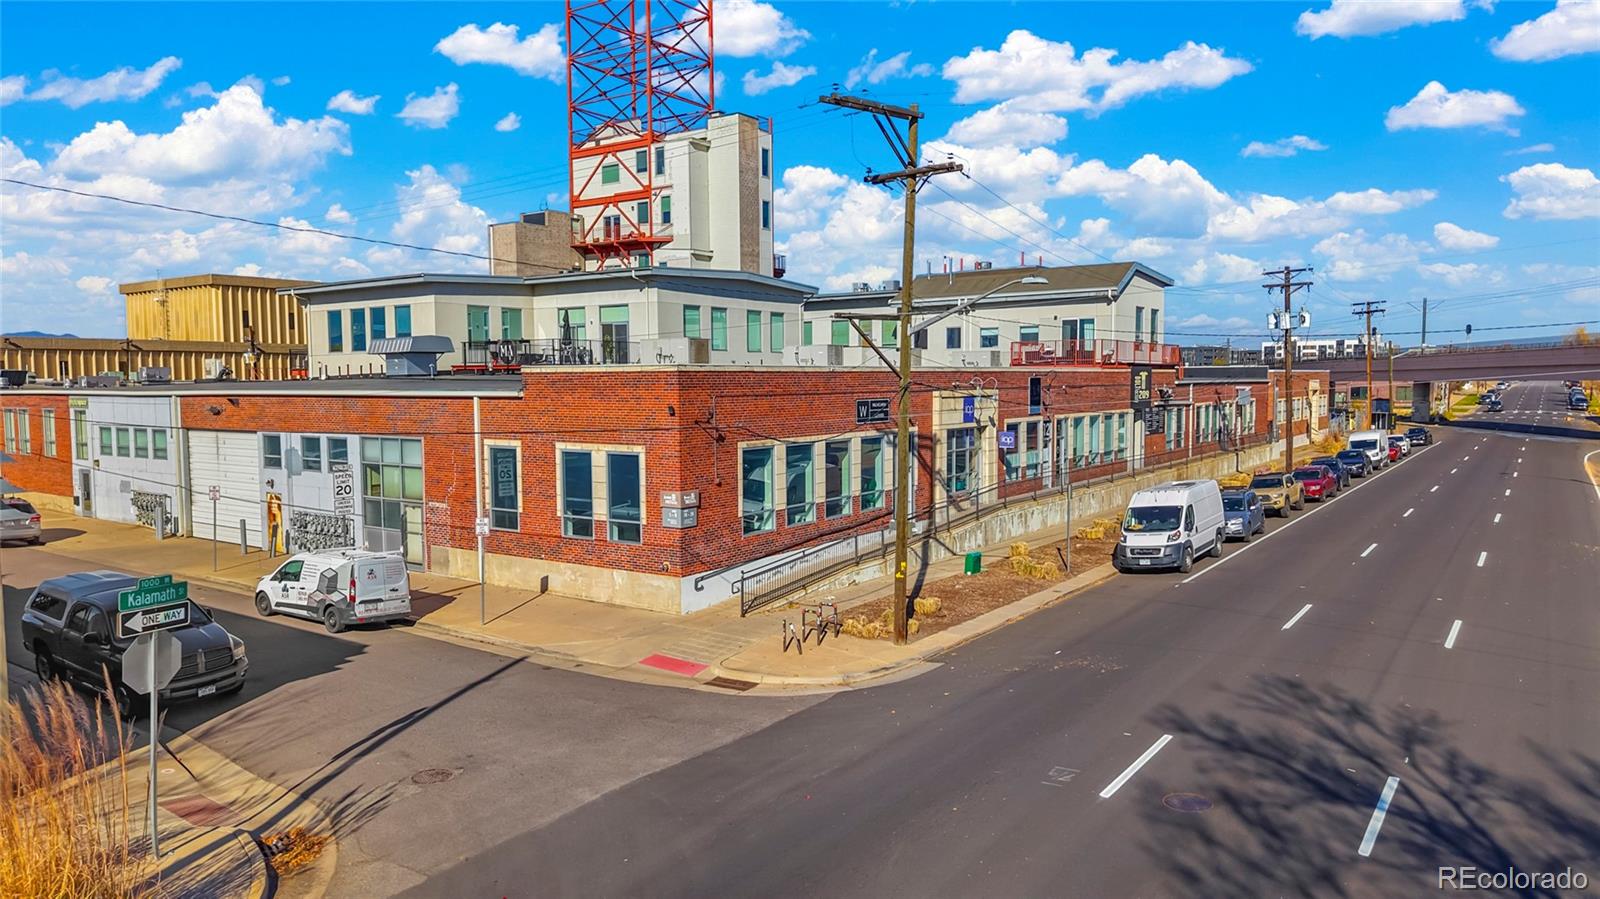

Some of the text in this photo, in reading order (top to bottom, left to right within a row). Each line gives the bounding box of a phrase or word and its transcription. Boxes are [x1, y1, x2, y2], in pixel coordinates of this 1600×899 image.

[858, 405, 868, 417] W
[336, 484, 352, 496] 20
[141, 578, 160, 588] 1000
[127, 587, 177, 608] Kalamath
[142, 609, 183, 626] ONE WAY
